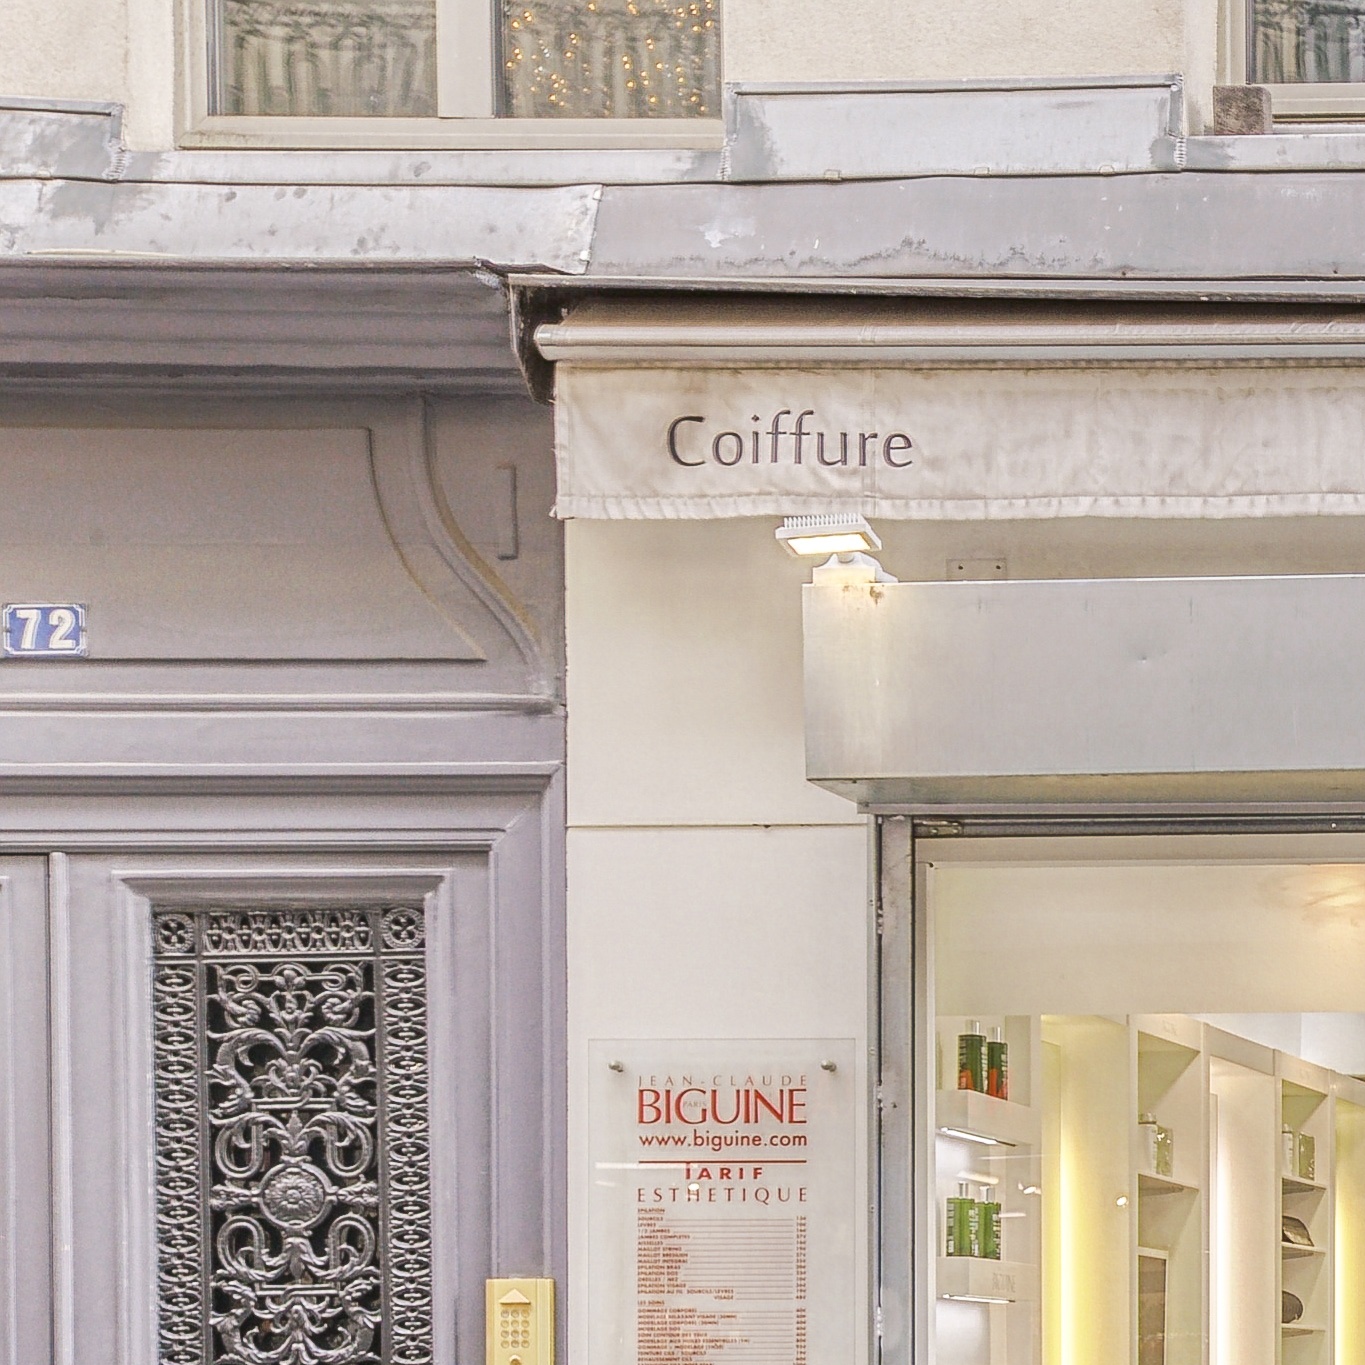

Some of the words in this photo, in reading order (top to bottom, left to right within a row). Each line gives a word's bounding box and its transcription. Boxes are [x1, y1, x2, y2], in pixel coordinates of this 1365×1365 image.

[667, 409, 914, 467] Coiffure
[16, 609, 76, 649] 72
[638, 1075, 807, 1086] JEAN-CLAUDE
[638, 1088, 807, 1124] BIGUINE
[639, 1130, 807, 1152] www.biguine.com
[685, 1162, 763, 1180] TARIF
[638, 1187, 807, 1205] ESTHETIQUE
